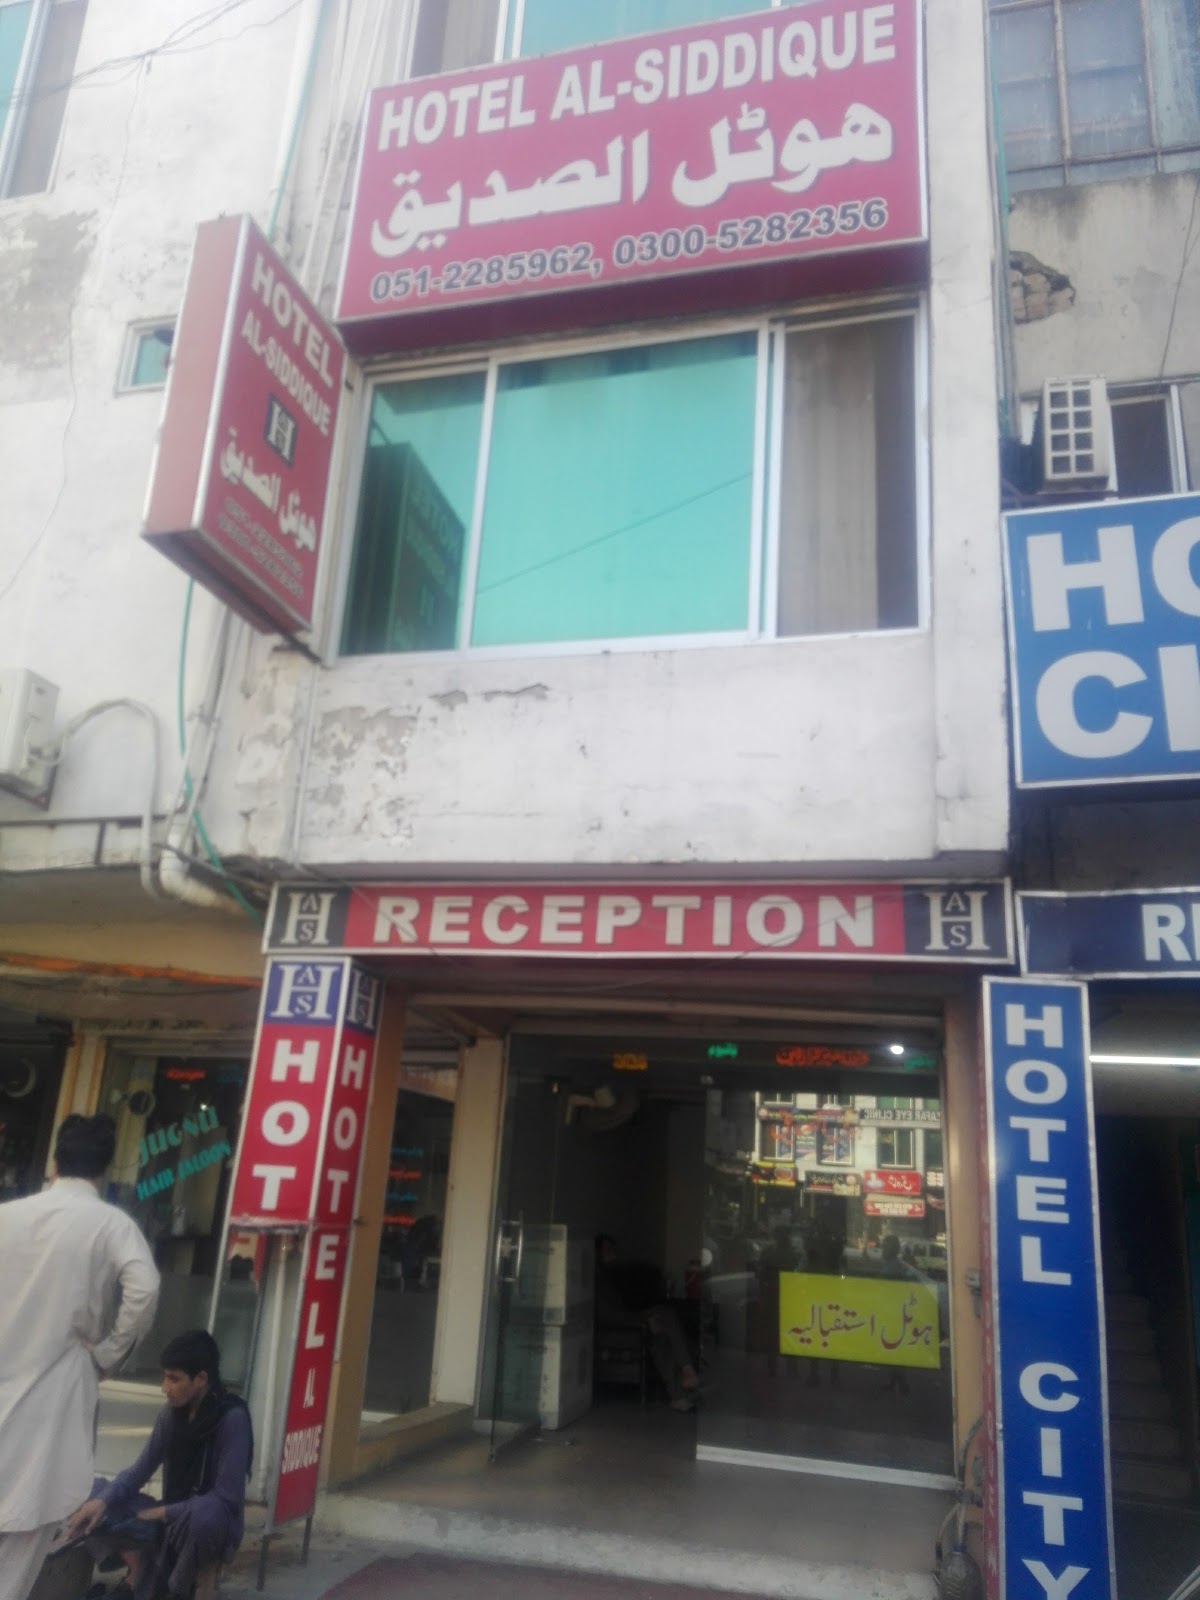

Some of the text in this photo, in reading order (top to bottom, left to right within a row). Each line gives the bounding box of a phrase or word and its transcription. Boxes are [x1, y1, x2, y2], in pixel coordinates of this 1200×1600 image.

[378, 5, 896, 152] HOTEL AL-SIDDIQUE
[614, 197, 887, 267] 0300-5282356
[240, 308, 331, 437] AL-SIDDIQUE
[250, 253, 334, 389] HOTEL
[373, 894, 876, 949] RECEPTION
[304, 1043, 367, 1349] HOTEL
[1005, 1004, 1090, 1600] HOTEL CITY
